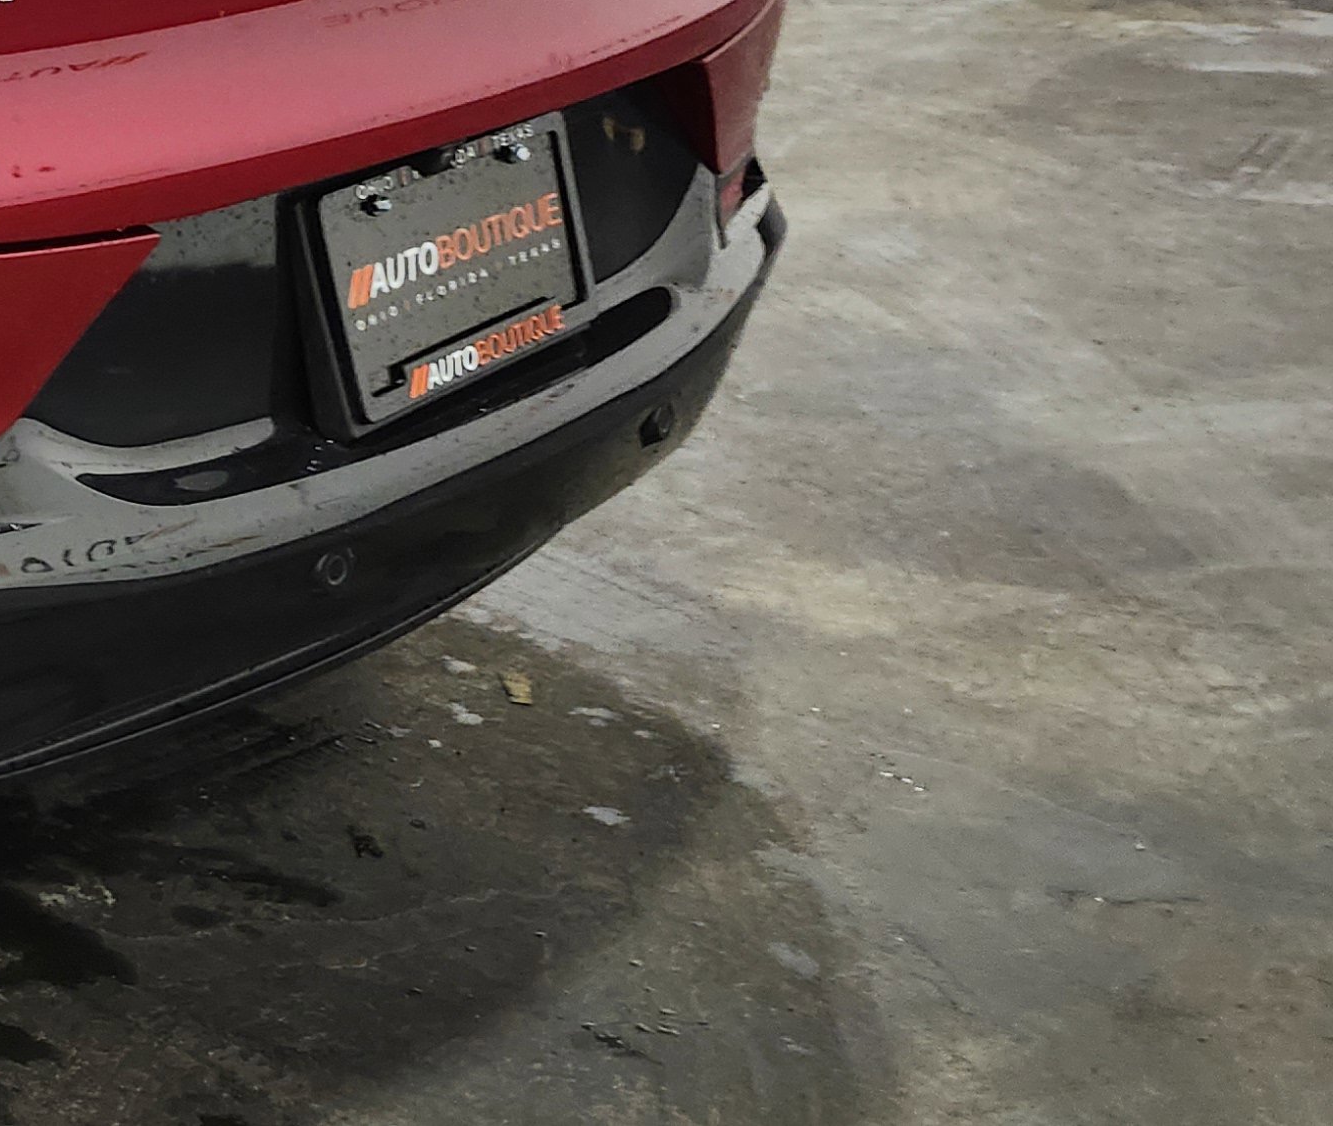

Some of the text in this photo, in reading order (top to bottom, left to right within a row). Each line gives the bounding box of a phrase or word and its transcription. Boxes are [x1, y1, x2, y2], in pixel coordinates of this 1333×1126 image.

[354, 238, 562, 332] OHIO FLORIDA TEXAS
[369, 192, 563, 299] AUTOBOUTIQUE
[427, 304, 567, 389] AUTOBOUTIQUE
